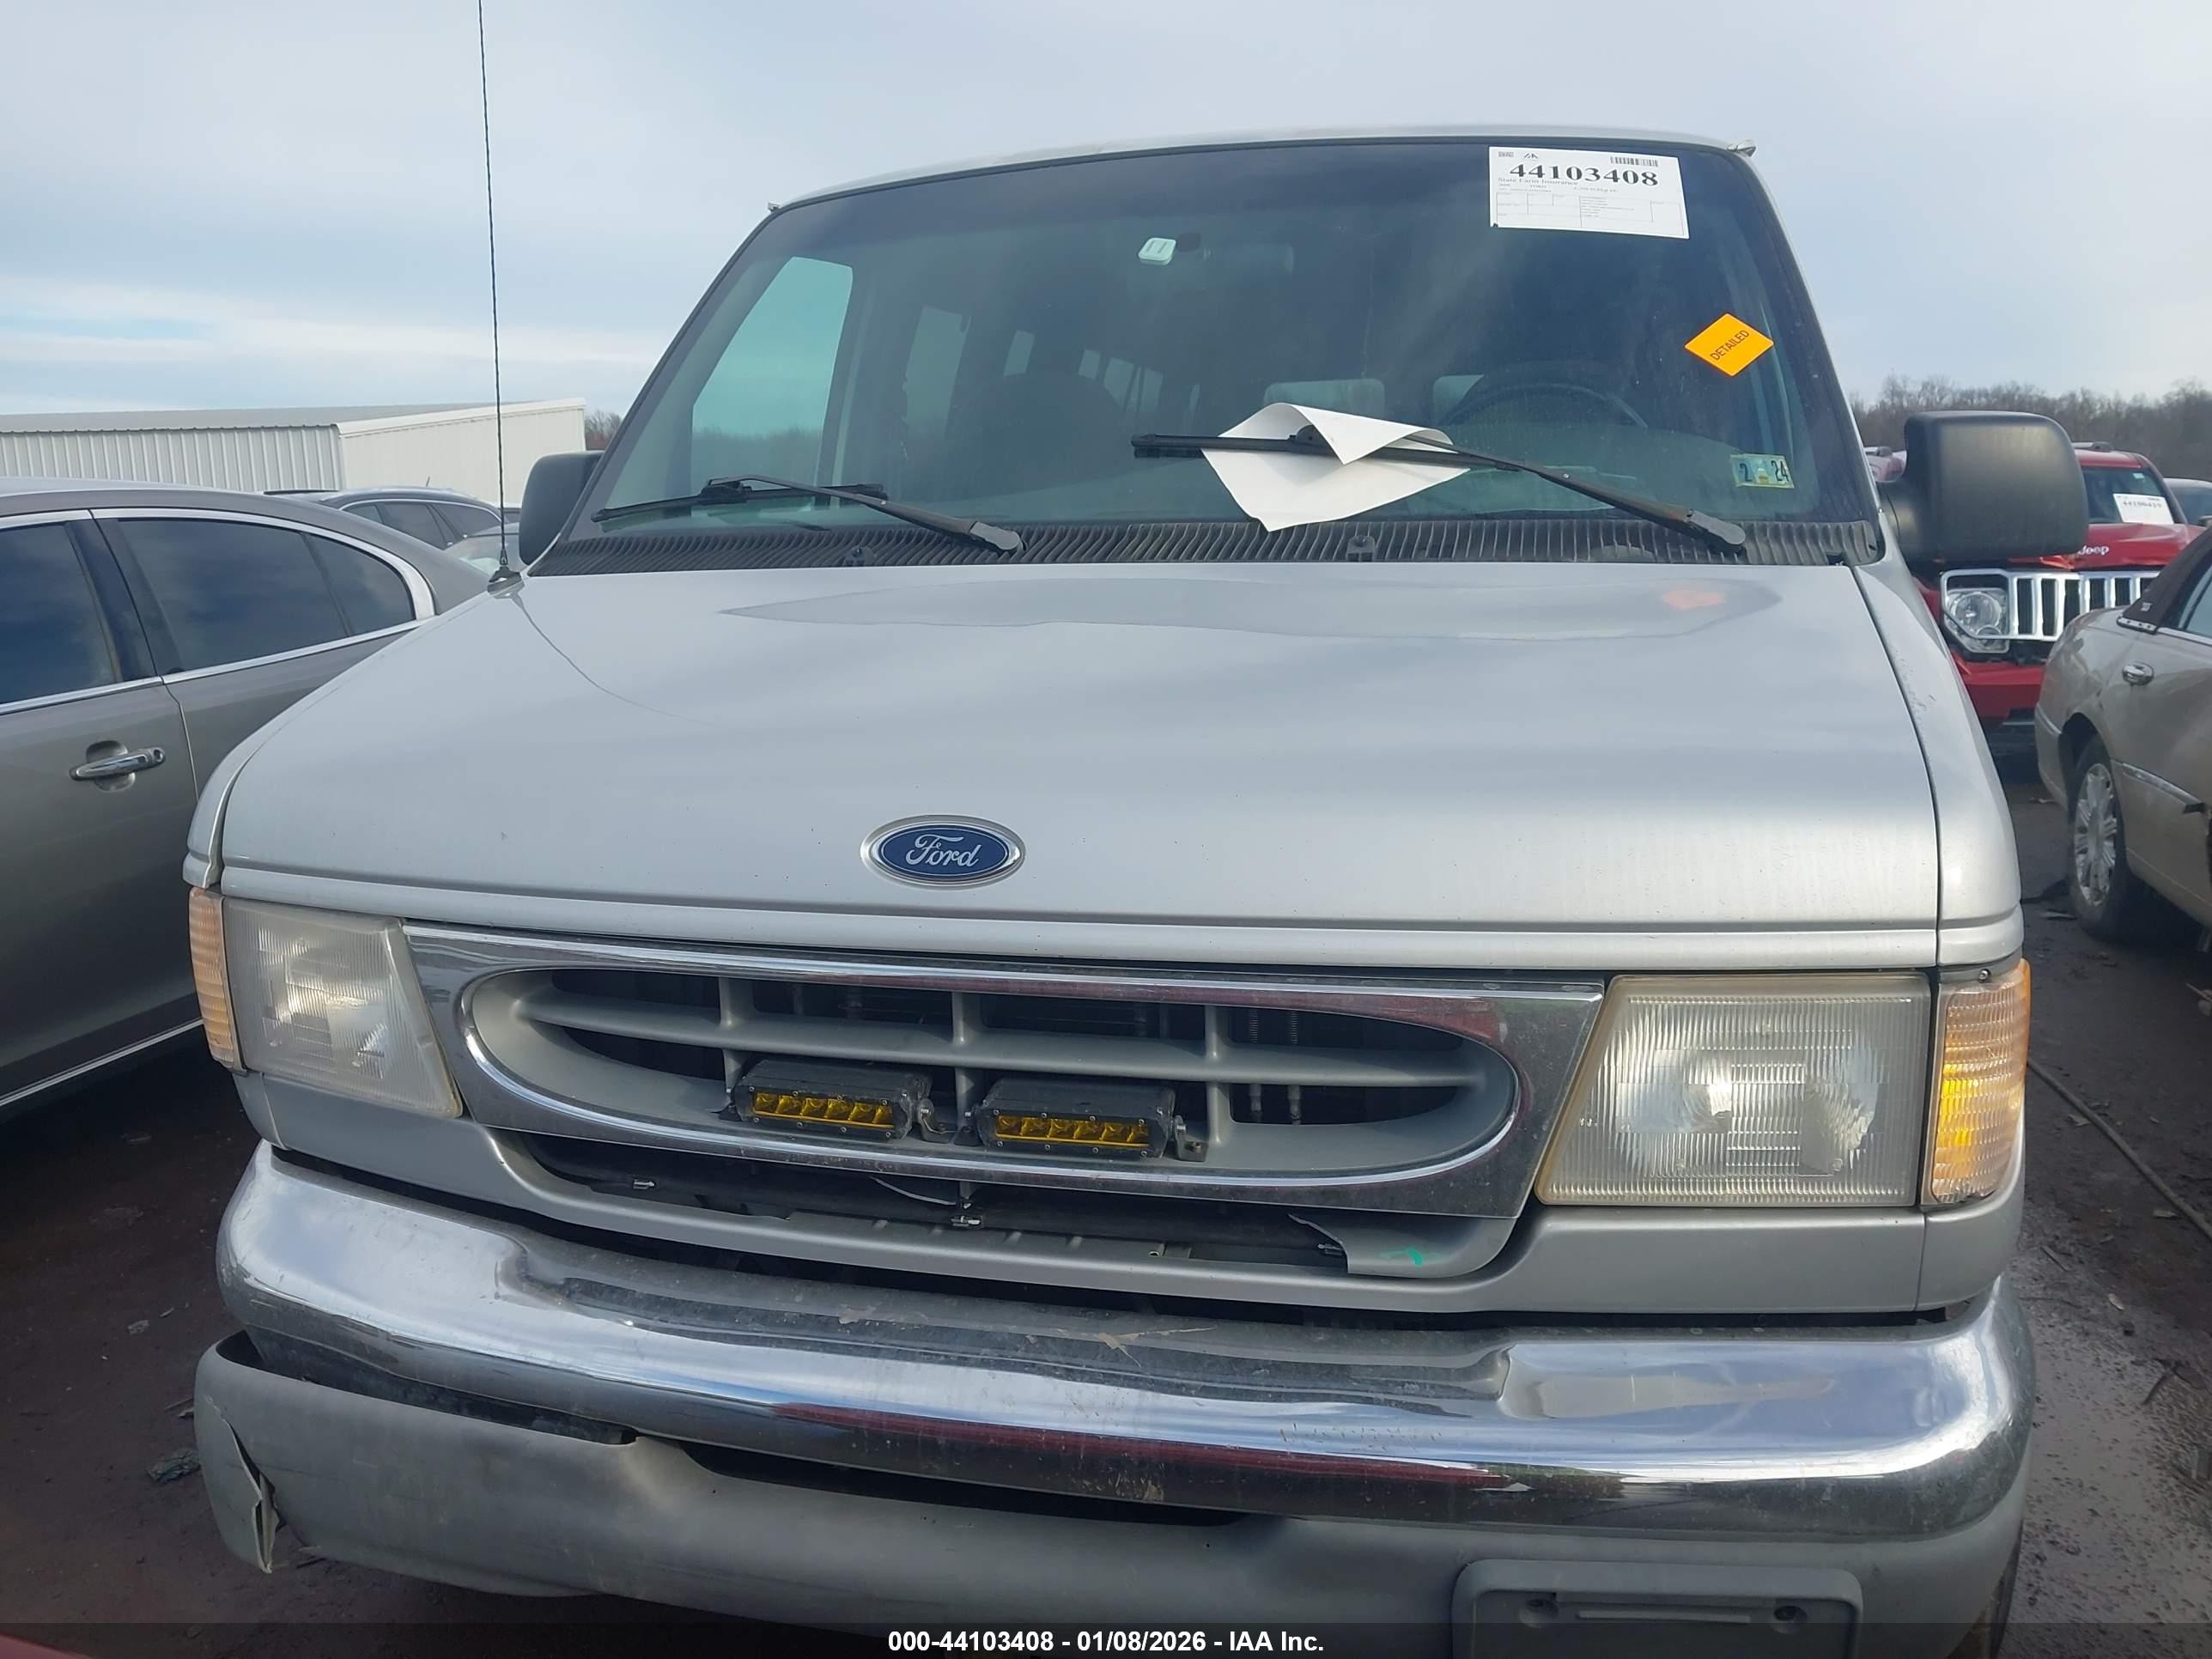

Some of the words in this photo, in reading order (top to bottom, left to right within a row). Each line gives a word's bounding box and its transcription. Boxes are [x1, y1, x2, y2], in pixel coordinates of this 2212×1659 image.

[1510, 163, 1659, 186] 44103408
[1710, 330, 1750, 361] DETAILED
[2078, 544, 2110, 556] Jeep
[905, 834, 982, 866] Ford
